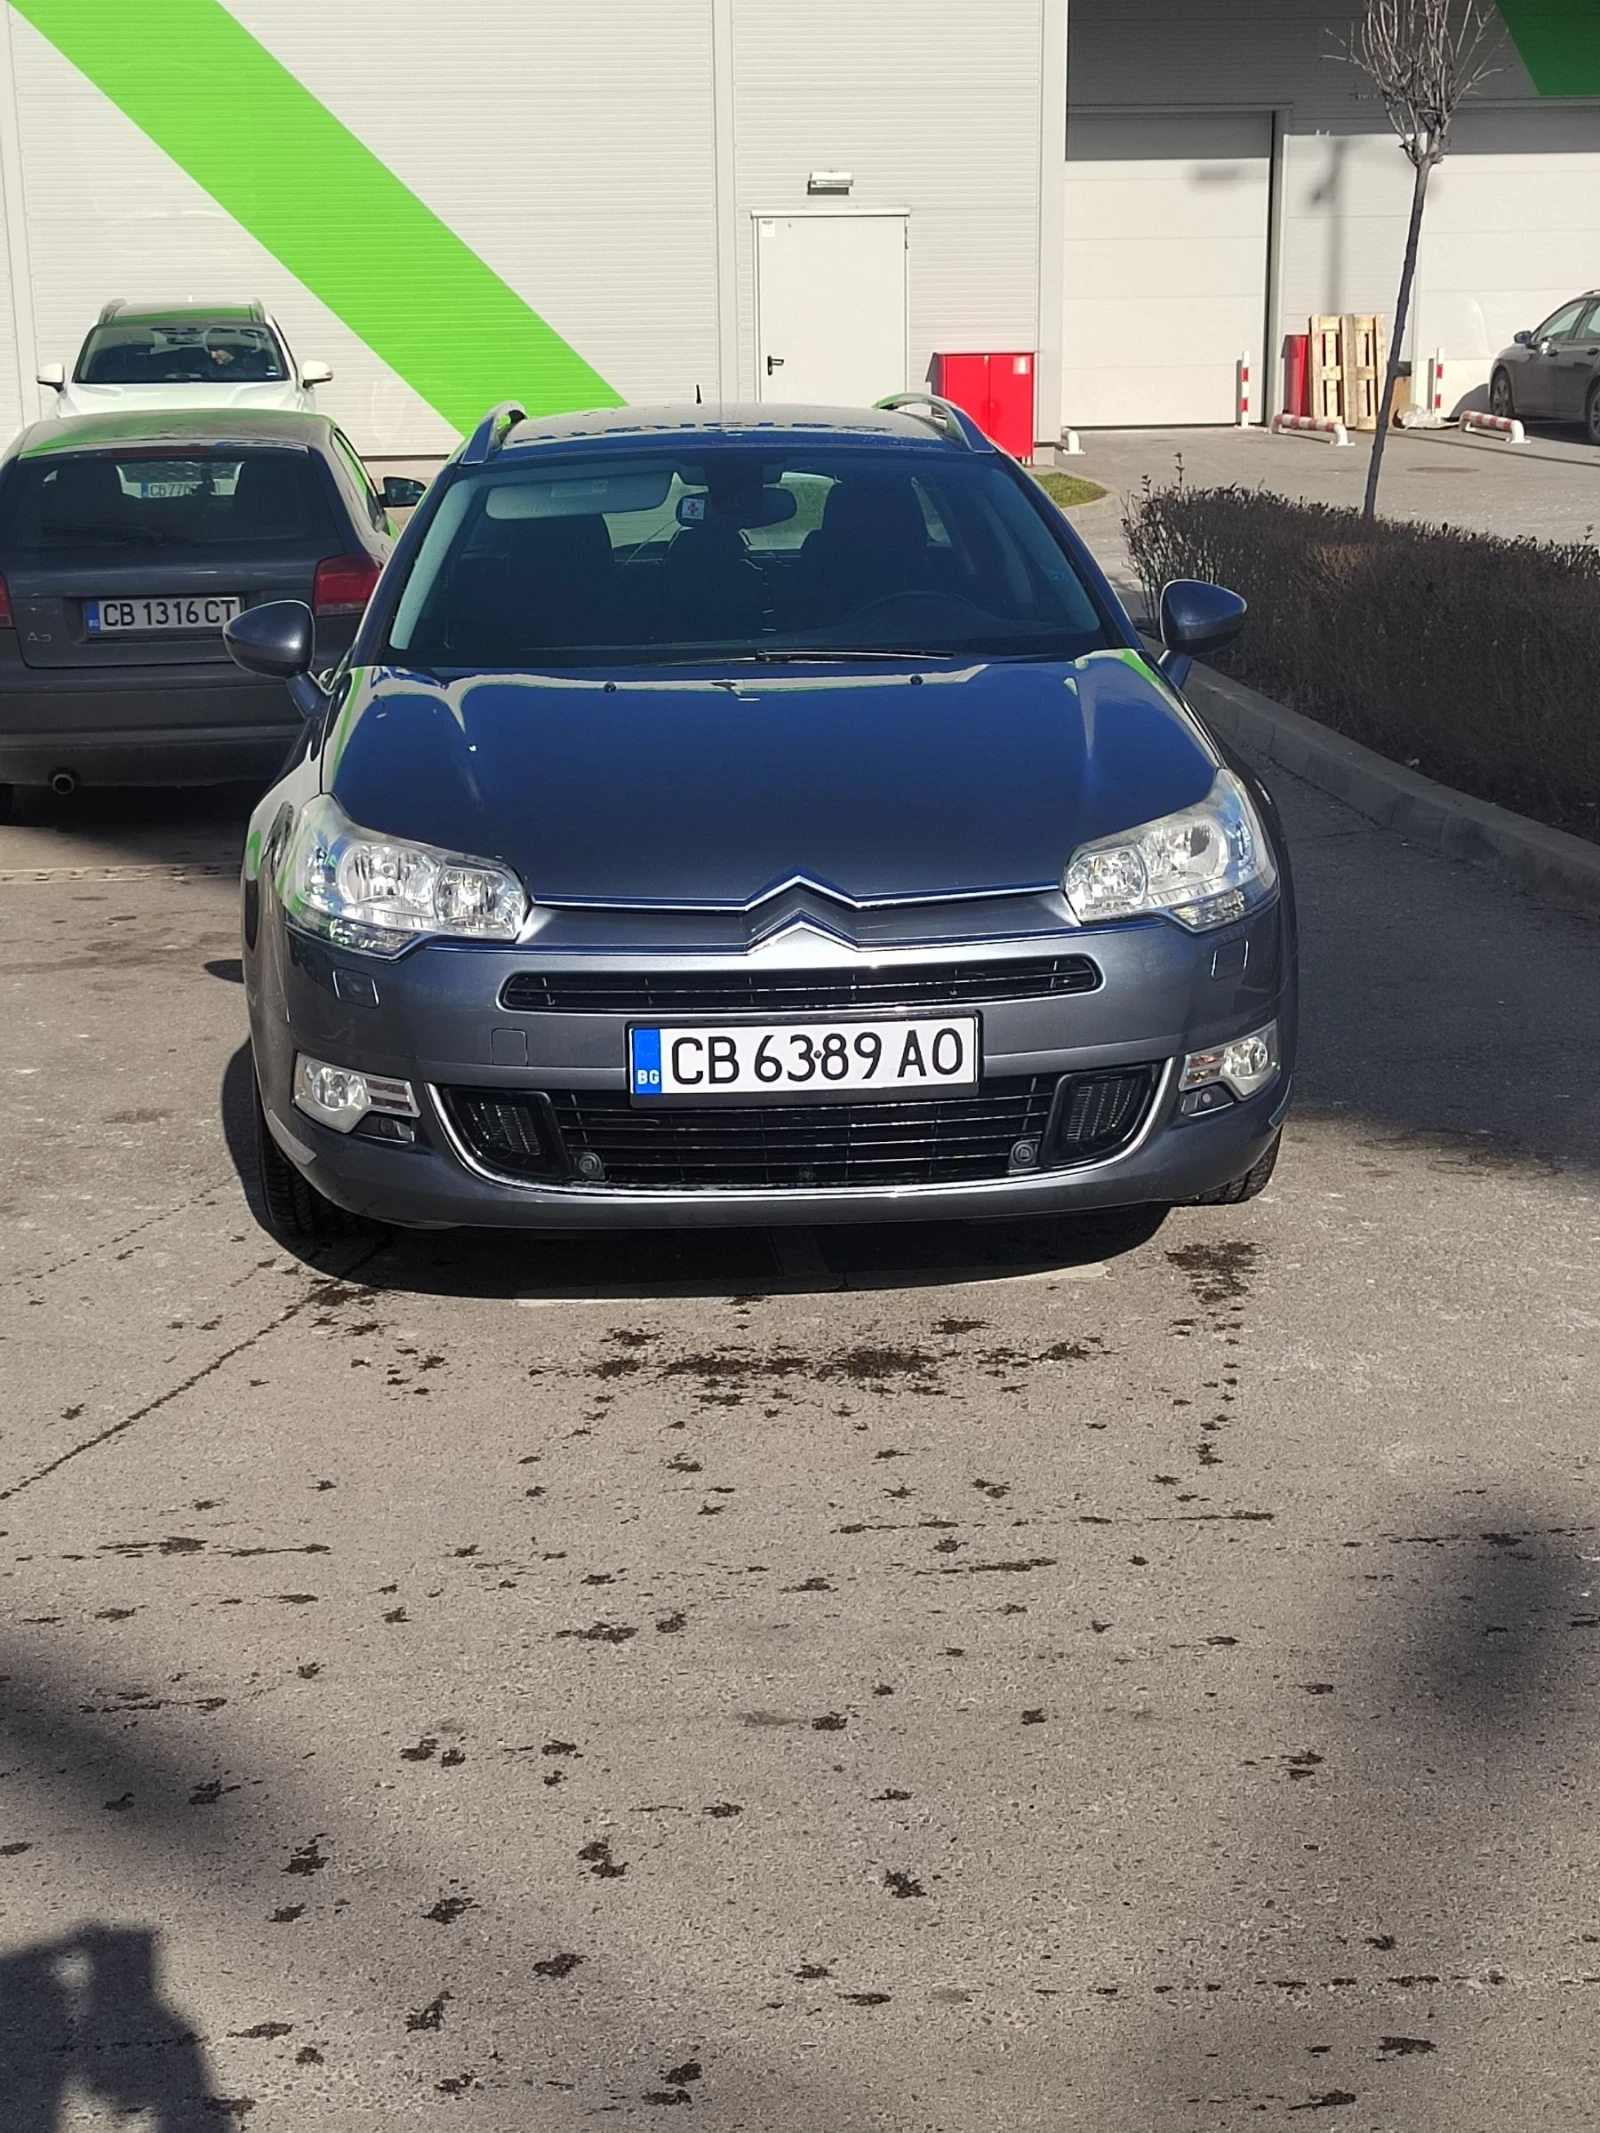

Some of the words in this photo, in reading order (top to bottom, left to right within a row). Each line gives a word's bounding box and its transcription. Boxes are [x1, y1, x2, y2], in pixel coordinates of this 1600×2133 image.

[103, 603, 135, 626] CB
[143, 602, 199, 625] 1316
[205, 600, 236, 624] CT
[671, 1036, 740, 1085] CB
[754, 1032, 882, 1084] 6389
[897, 1027, 963, 1078] AO
[637, 1069, 660, 1085] BG
